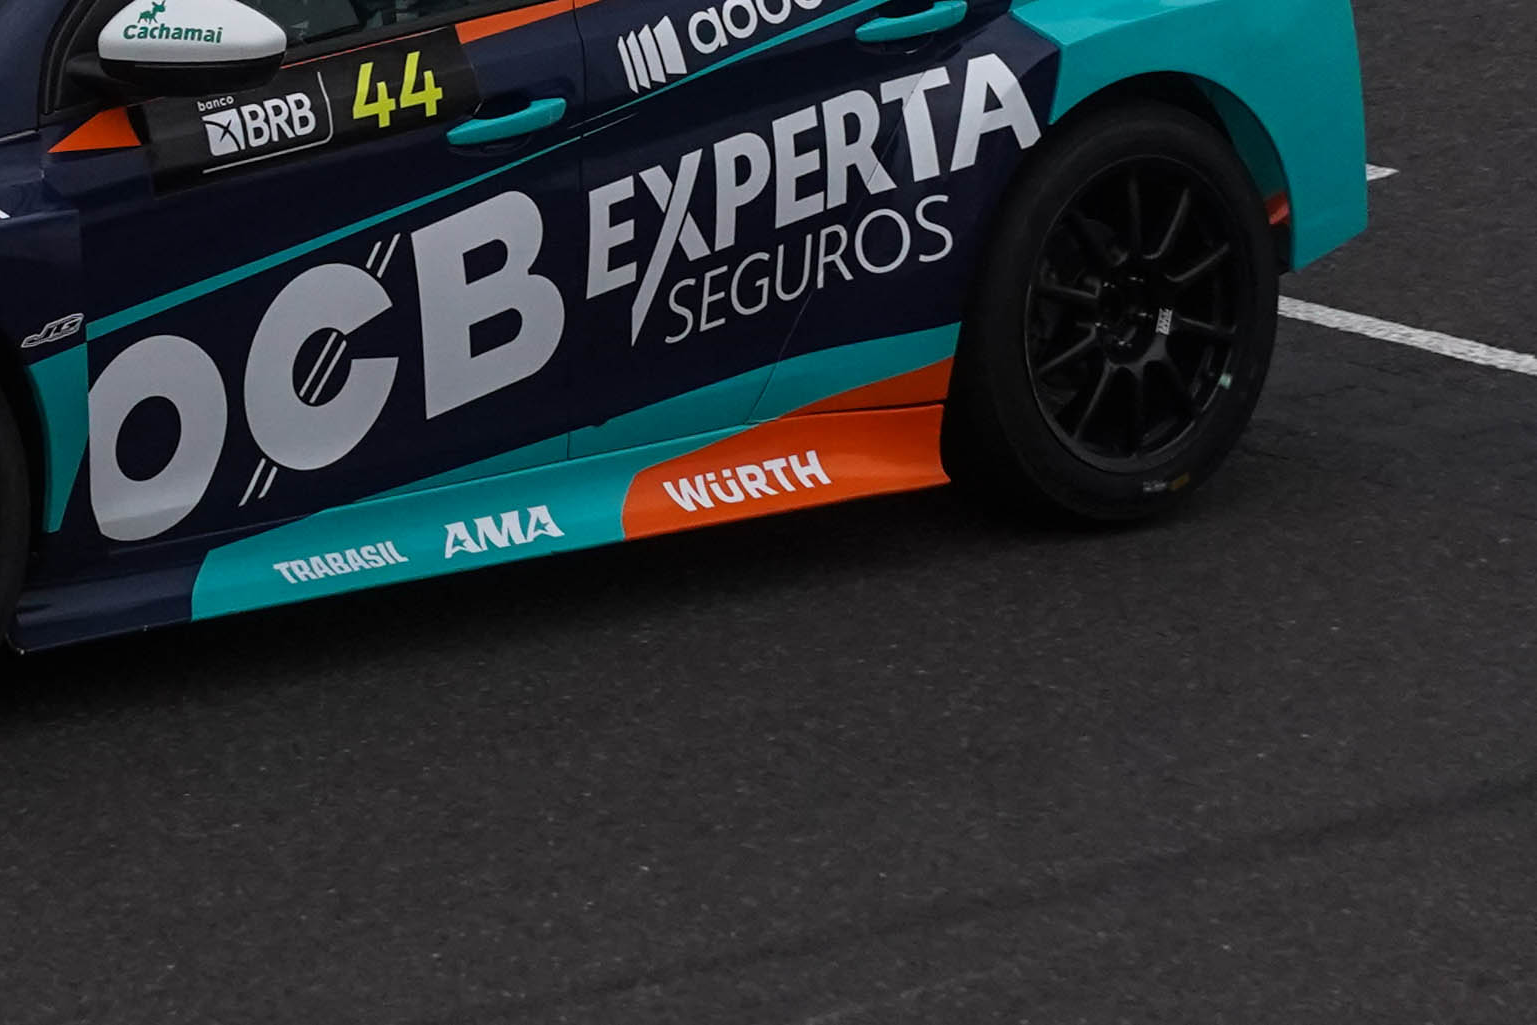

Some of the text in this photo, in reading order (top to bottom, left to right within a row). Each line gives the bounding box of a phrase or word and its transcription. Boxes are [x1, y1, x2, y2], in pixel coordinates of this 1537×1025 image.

[123, 21, 223, 44] Cachamai
[196, 93, 235, 113] banco
[351, 50, 444, 128] 44
[240, 91, 317, 152] BRB
[585, 52, 1043, 348] EXPERTA
[664, 194, 955, 345] SEGUROS
[88, 190, 566, 542] OCB
[663, 449, 832, 513] WÜRTH
[272, 539, 410, 584] TRABASIL
[443, 504, 565, 559] AMA
